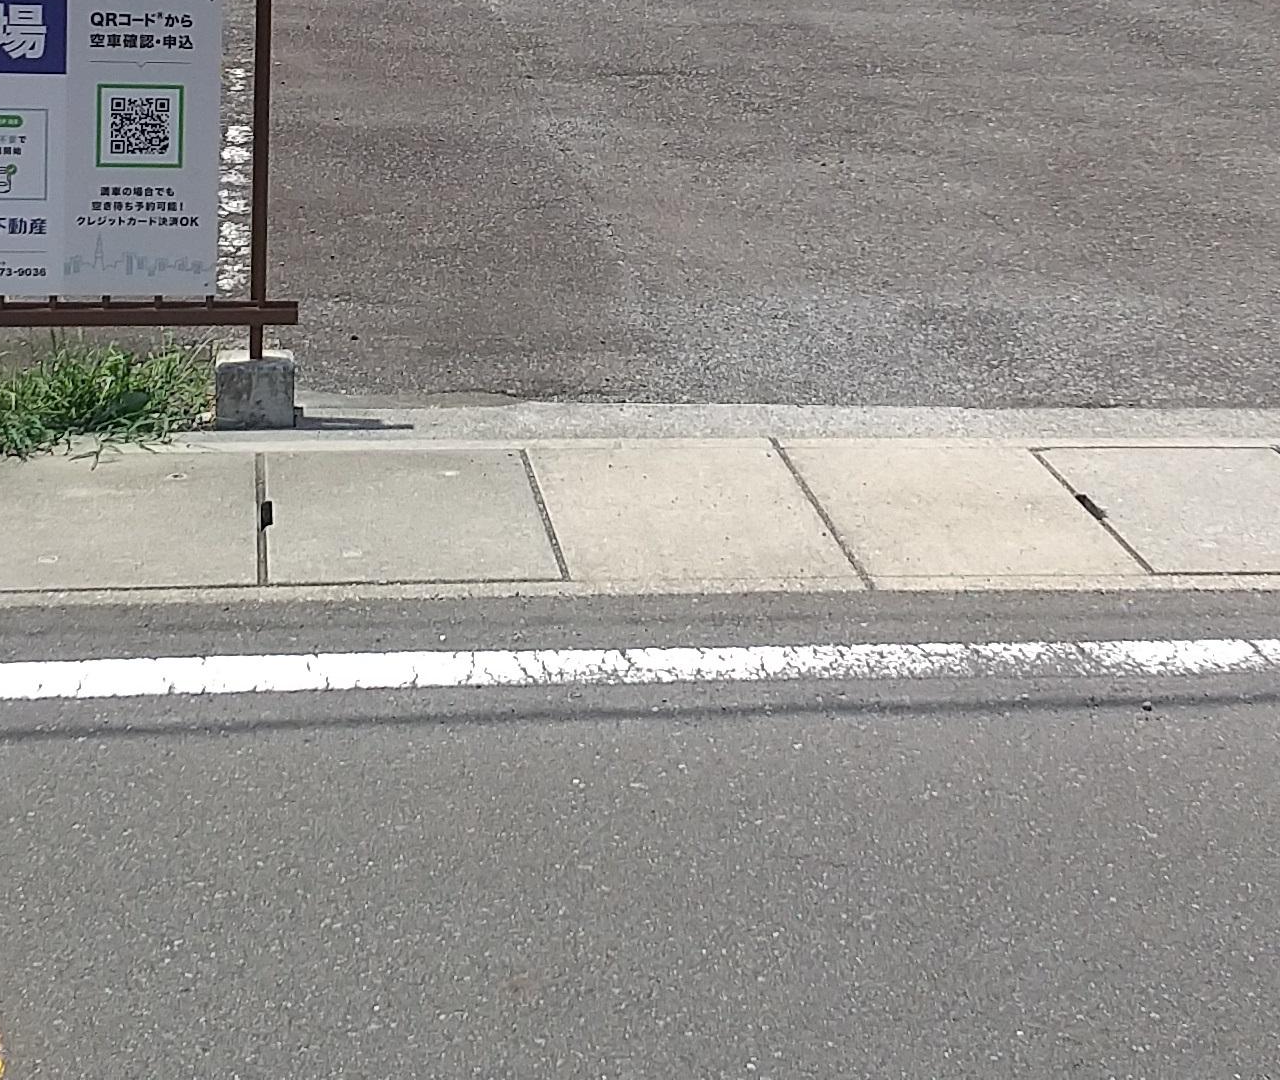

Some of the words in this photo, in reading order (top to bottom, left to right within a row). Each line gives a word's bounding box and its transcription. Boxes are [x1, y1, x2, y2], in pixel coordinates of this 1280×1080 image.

[89, 33, 193, 49] 空車確認・申込
[100, 186, 175, 197] 満車の場合でも
[76, 216, 199, 227] クレジットカード決済OK
